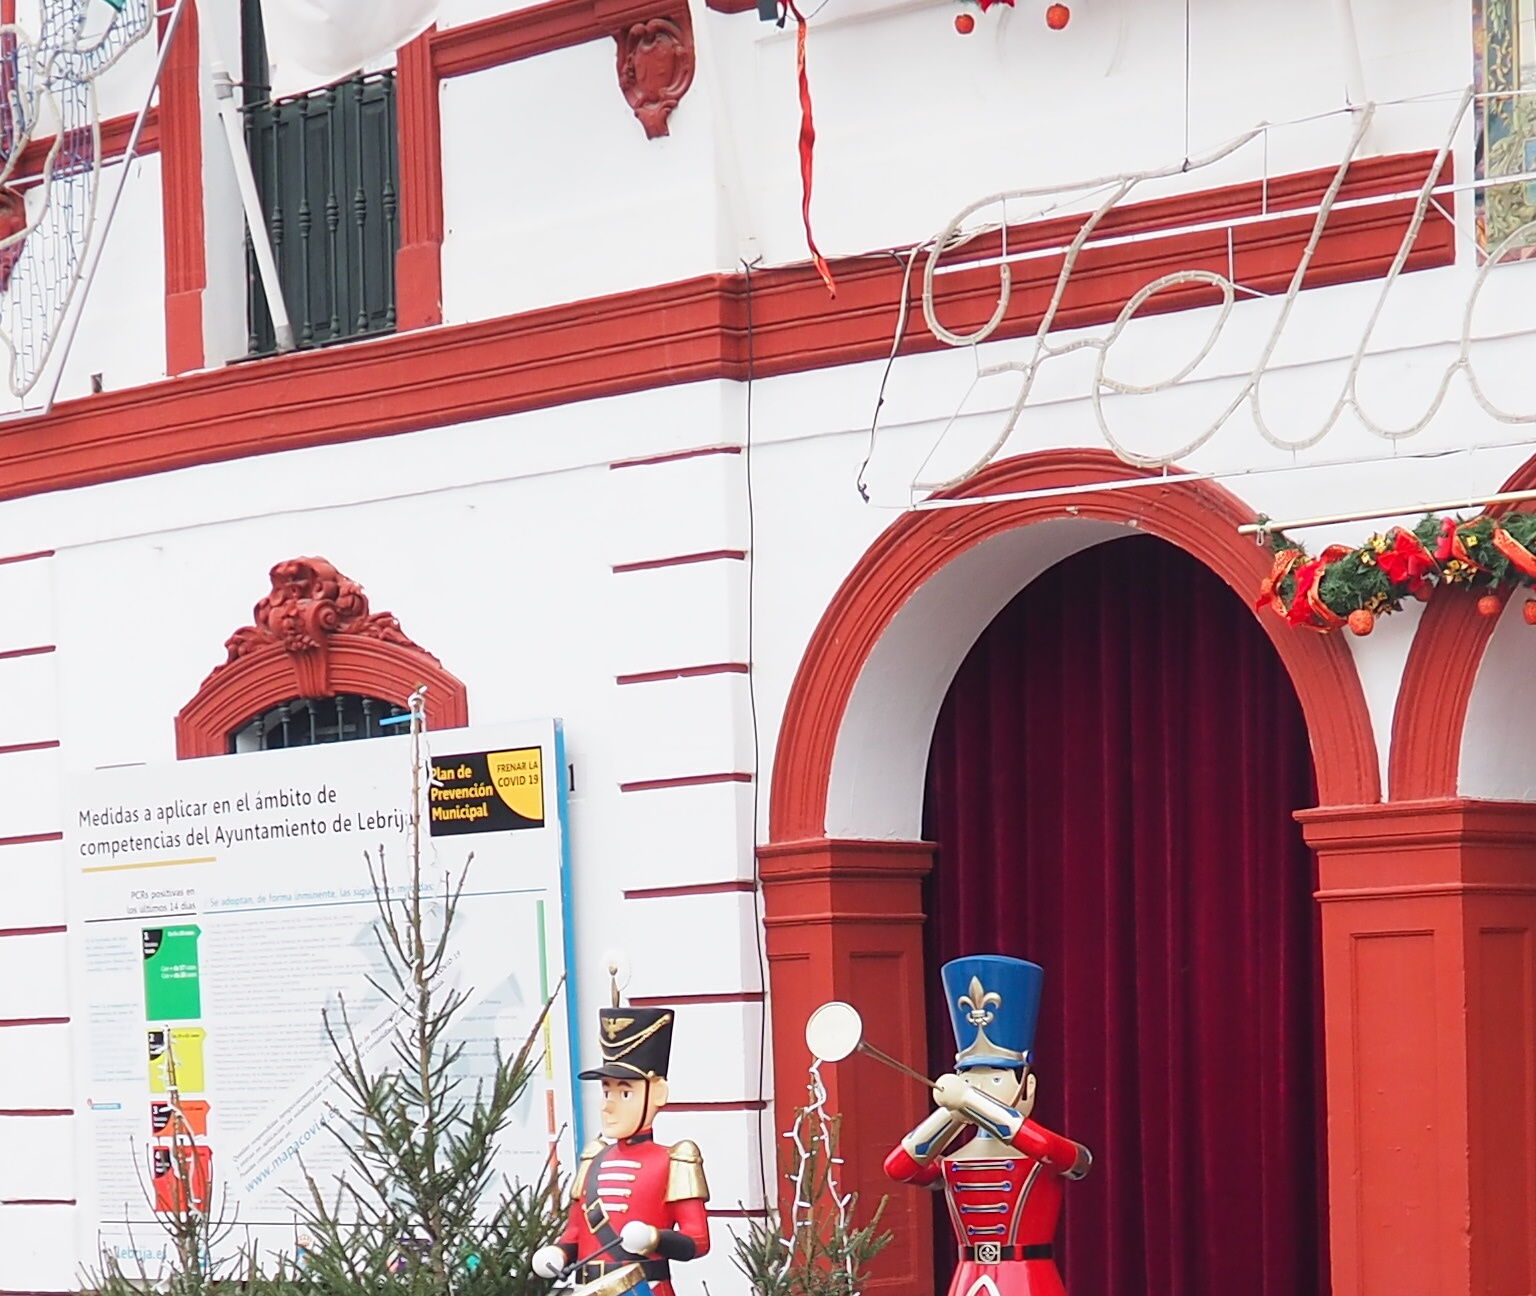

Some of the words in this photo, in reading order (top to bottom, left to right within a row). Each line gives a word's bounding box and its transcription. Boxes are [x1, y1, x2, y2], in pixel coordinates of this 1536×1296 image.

[431, 766, 455, 781] Plan
[457, 764, 472, 779] de
[496, 763, 527, 773] FRENAR
[528, 761, 538, 770] LA
[497, 775, 526, 787] COVID
[528, 774, 539, 785] 19
[431, 783, 494, 802] Prevención
[78, 807, 139, 829] Medidas
[143, 808, 153, 821] a
[156, 799, 208, 825] aplicar
[212, 800, 231, 815] en
[236, 792, 250, 813] el
[254, 788, 312, 811] ámbito
[316, 784, 338, 804] de
[431, 802, 489, 822] Municipal
[79, 831, 181, 859] competencias
[186, 825, 210, 847] del
[214, 815, 327, 853] Ayuntamiento
[332, 813, 353, 833] de
[151, 889, 184, 901] positivas
